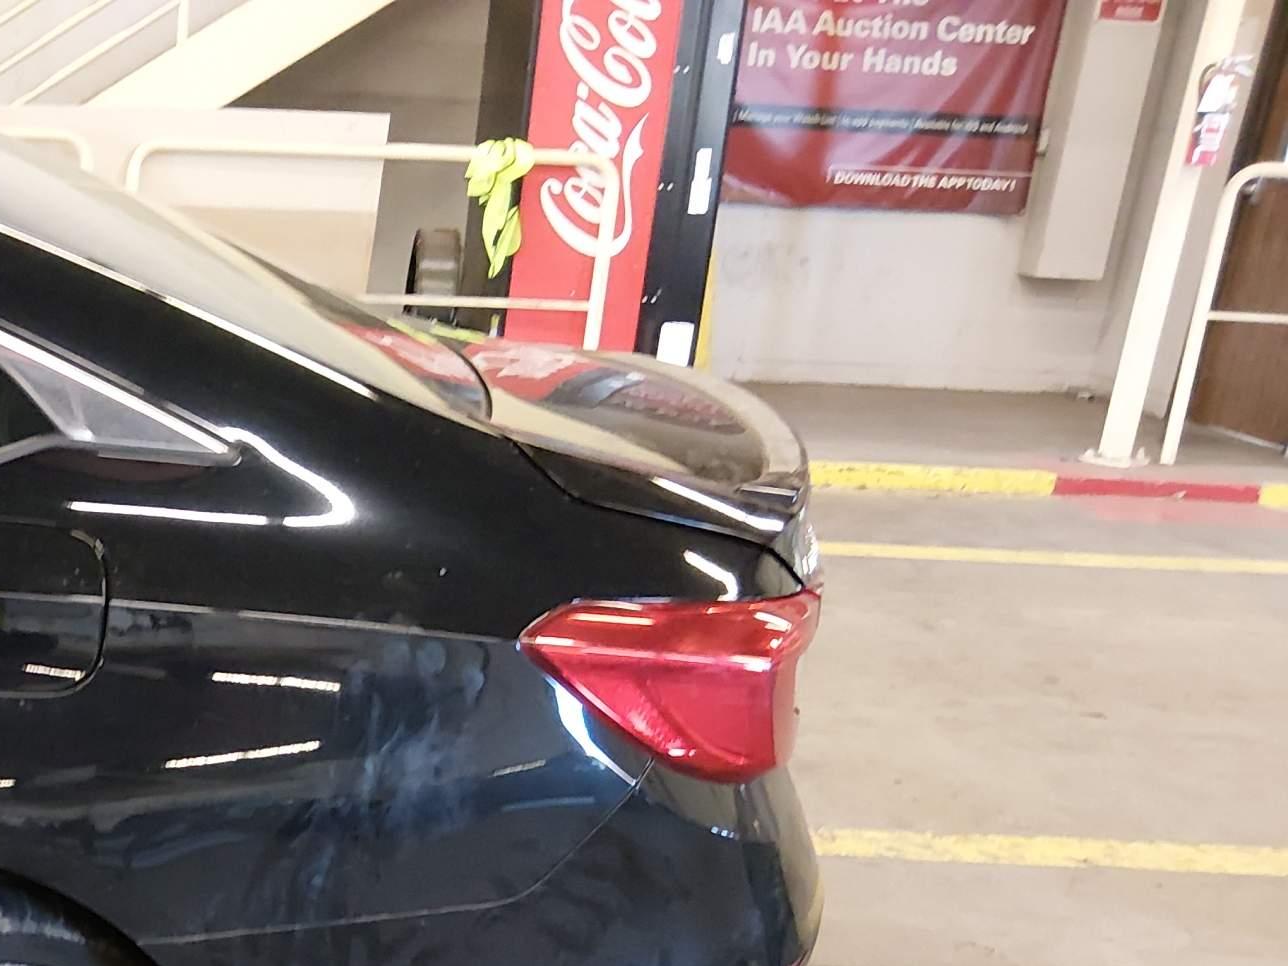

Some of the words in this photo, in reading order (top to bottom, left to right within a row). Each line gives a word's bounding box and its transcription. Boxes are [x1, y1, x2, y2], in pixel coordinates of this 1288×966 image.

[752, 6, 807, 34] IAA
[812, 10, 929, 41] Auction
[937, 16, 1036, 45] Center
[747, 41, 776, 68] In
[787, 44, 854, 71] Your
[862, 46, 958, 76] Hands
[834, 171, 911, 188] DOWNLOAD
[912, 174, 937, 189] THE
[937, 176, 963, 190] APP
